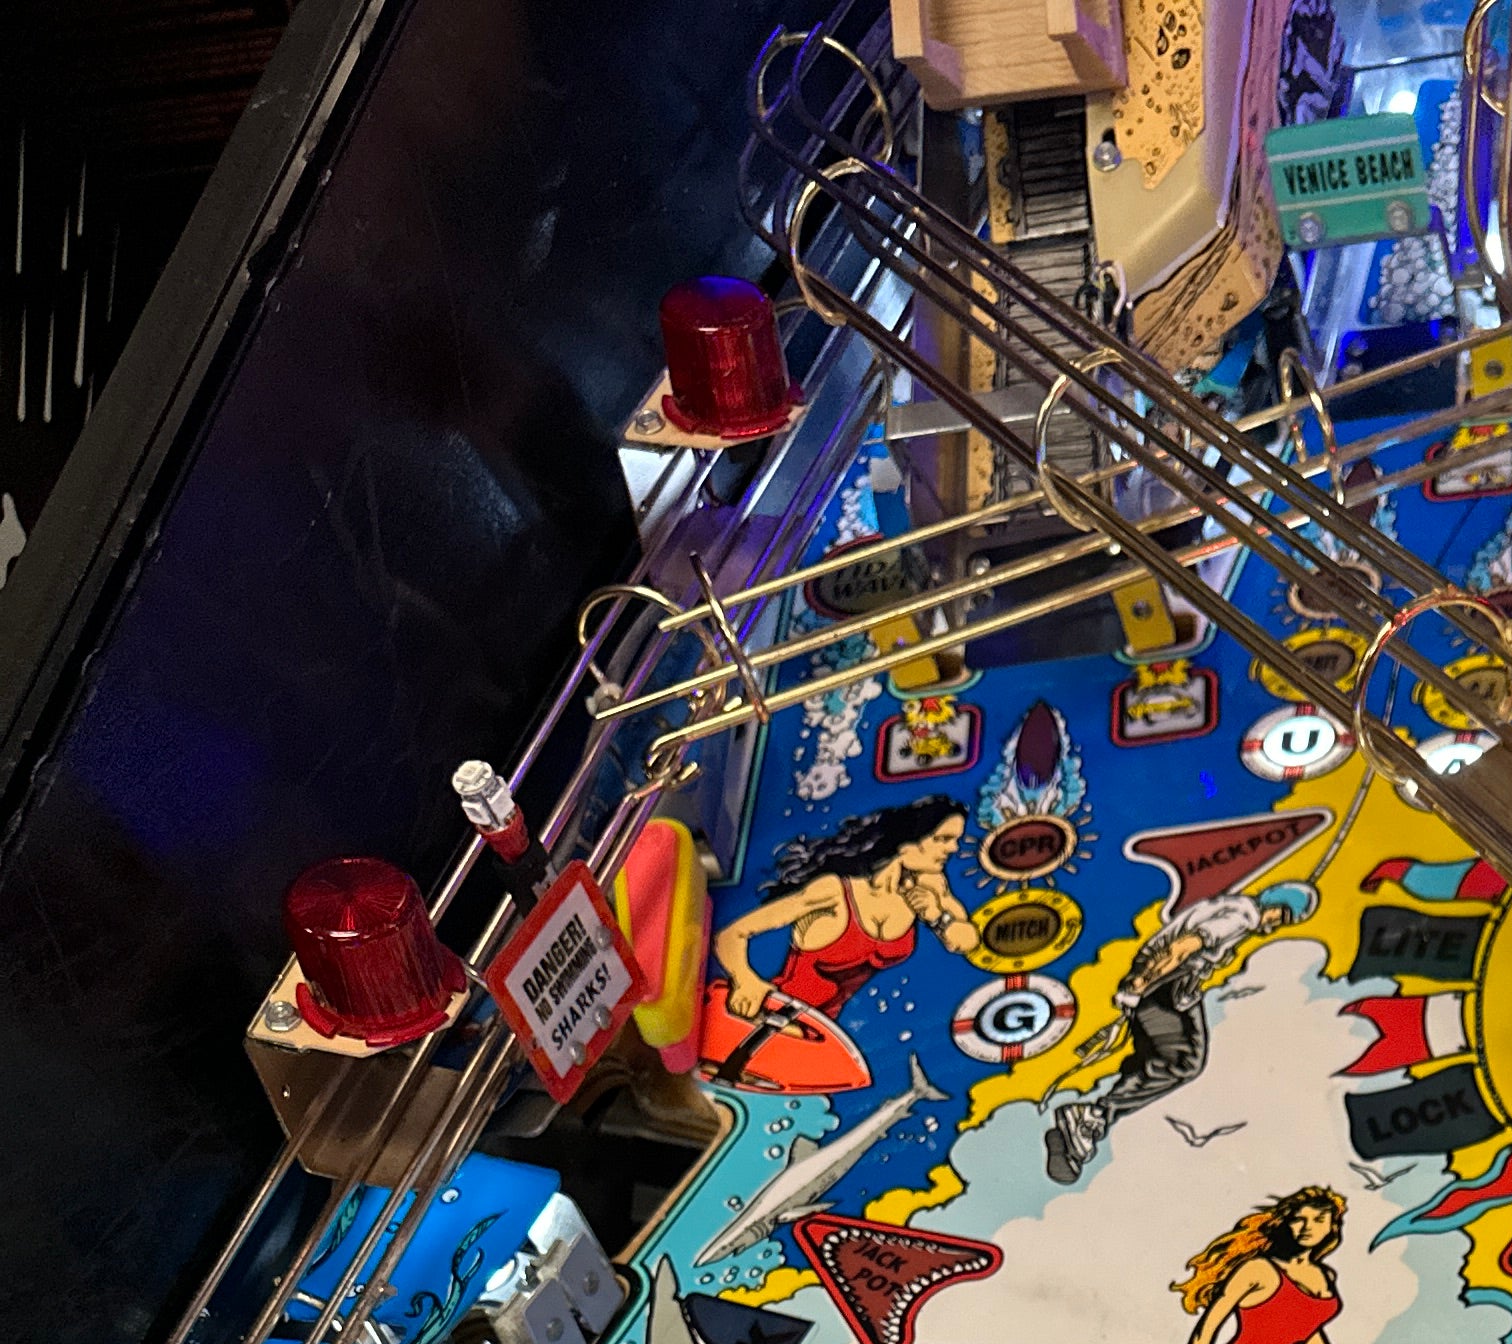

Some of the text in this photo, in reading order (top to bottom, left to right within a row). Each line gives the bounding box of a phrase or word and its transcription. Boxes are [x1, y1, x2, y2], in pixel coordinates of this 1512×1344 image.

[1283, 149, 1416, 195] VENICE BEACH
[1281, 730, 1320, 753] U
[1001, 834, 1053, 859] CPR
[1185, 822, 1302, 877] JACKPOT
[995, 916, 1051, 941] MITCH
[1368, 926, 1469, 962] LITE
[523, 913, 587, 1005] DANGER!
[534, 997, 553, 1026] NO
[551, 962, 612, 1051] SHARKS!
[993, 1002, 1036, 1033] G
[1366, 1088, 1475, 1143] LOCK
[853, 1241, 908, 1274] JACK
[853, 1267, 904, 1297] POT
